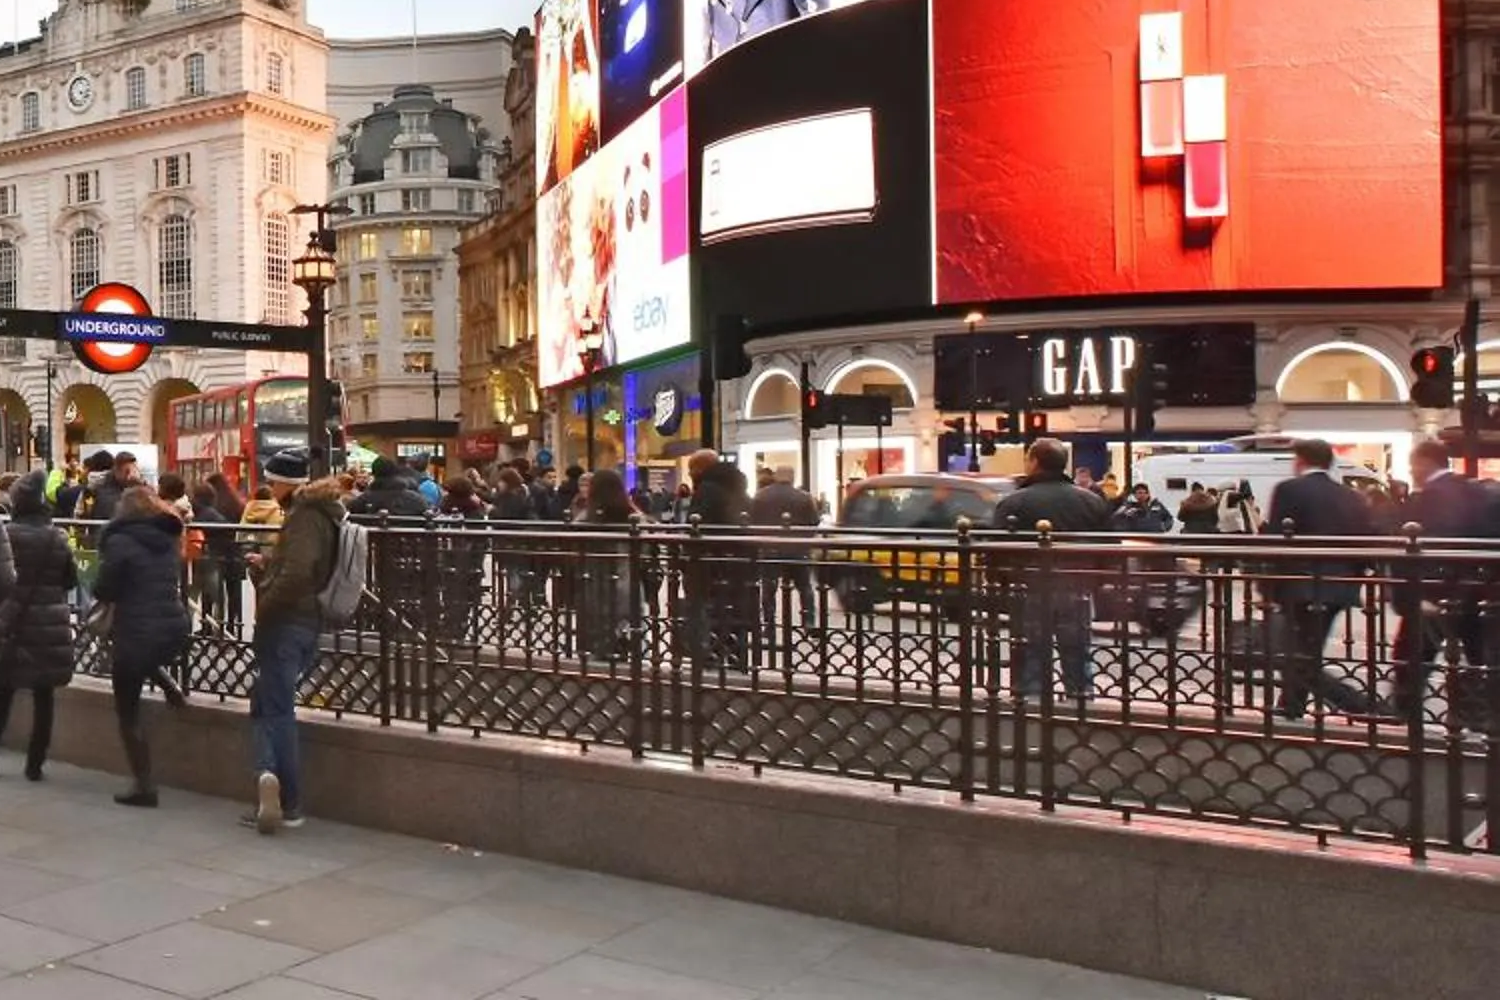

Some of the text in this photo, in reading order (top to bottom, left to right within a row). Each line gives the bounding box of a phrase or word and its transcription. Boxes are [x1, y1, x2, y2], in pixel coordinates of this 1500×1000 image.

[65, 319, 165, 337] UNDERGROUND
[632, 291, 668, 334] ebay
[1043, 336, 1135, 395] GAP
